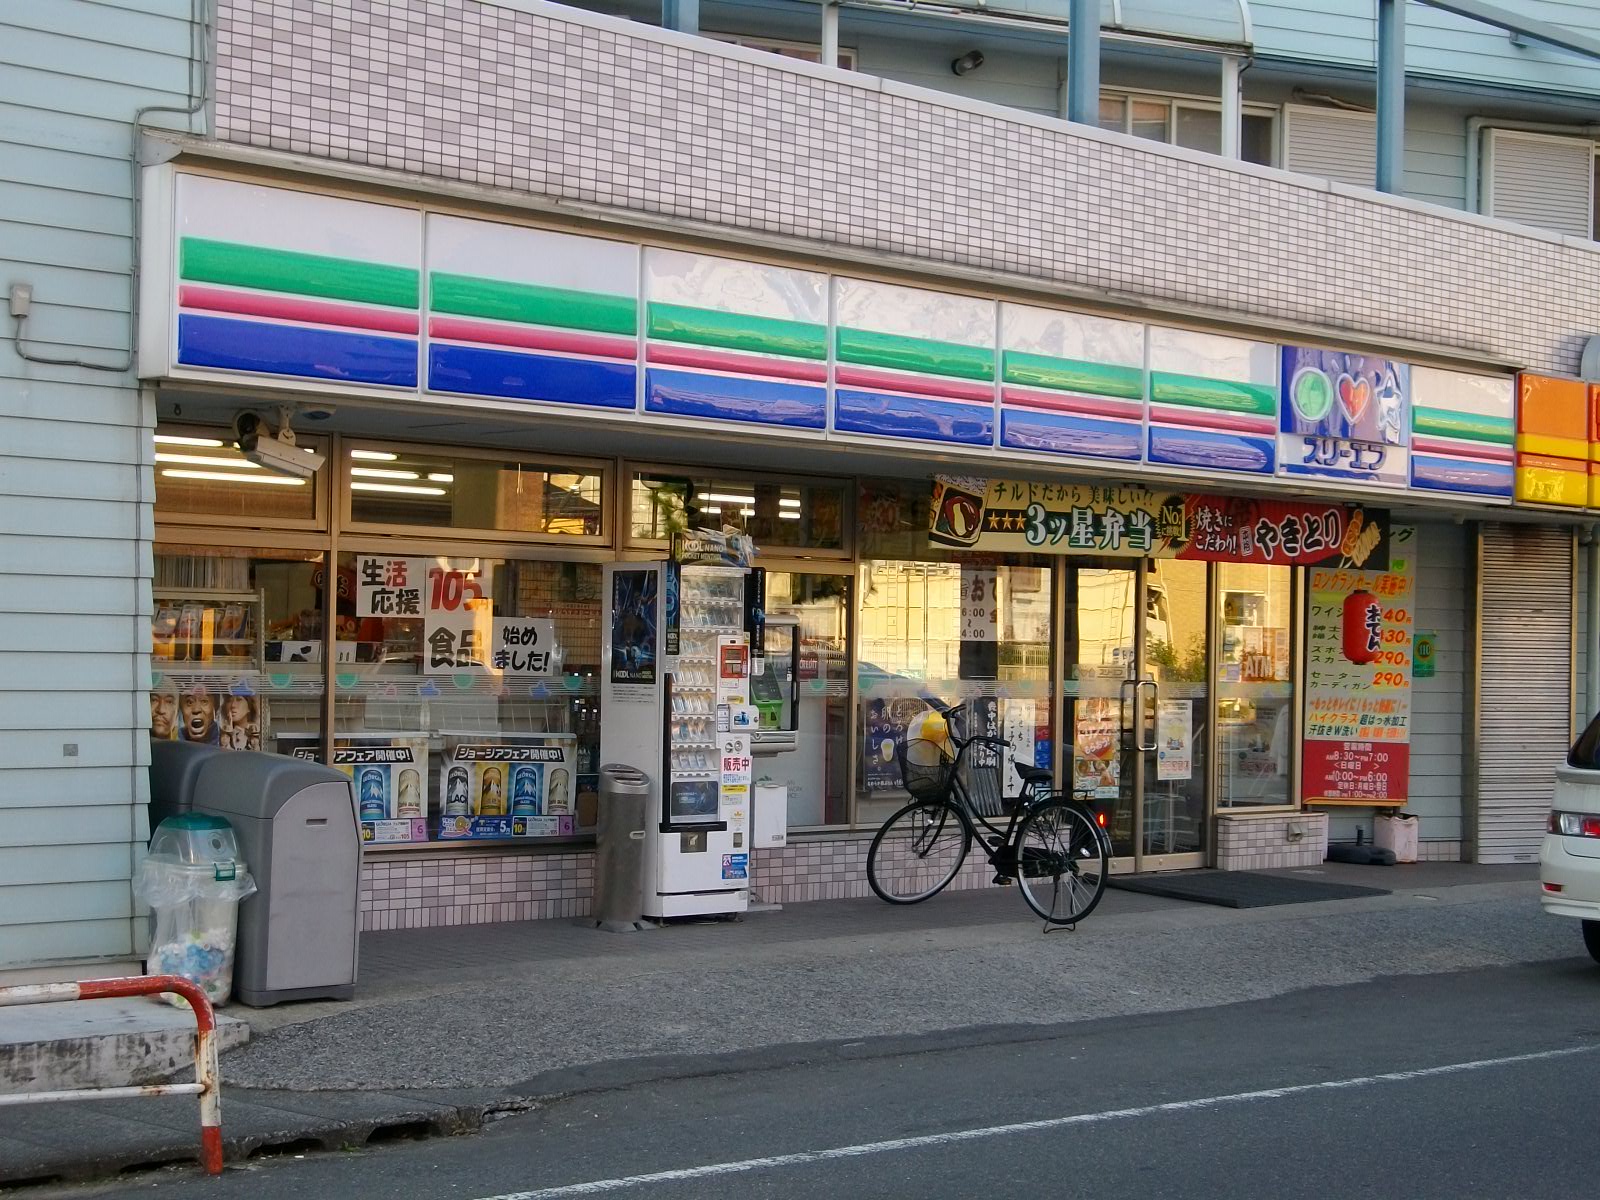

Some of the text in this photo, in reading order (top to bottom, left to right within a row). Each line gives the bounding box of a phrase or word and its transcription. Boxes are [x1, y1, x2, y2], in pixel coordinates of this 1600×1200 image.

[1303, 437, 1387, 470] スリーエフ
[1026, 503, 1152, 551] 3ツ星弁当
[1195, 505, 1233, 532] 焼きに
[1195, 534, 1237, 555] こだわり!
[1255, 509, 1342, 560] やきとり
[682, 540, 724, 553] KOOL NANO
[362, 558, 408, 587] 生活
[371, 588, 420, 615] 応援
[1380, 608, 1412, 625] 40円
[502, 625, 538, 646] 始め
[1366, 604, 1381, 652] おでん
[428, 627, 484, 668] 食品
[494, 650, 550, 672] ました!
[1245, 656, 1271, 678] ATM
[615, 670, 629, 679] KOOL
[1310, 672, 1361, 680] セーター
[1373, 672, 1409, 688] 290円
[1310, 682, 1371, 690] カーディガン
[1308, 713, 1359, 723] ハイクラス
[458, 747, 562, 761] ジョージアフェア開催中!
[723, 757, 749, 772] 販売中
[417, 825, 424, 834] 6
